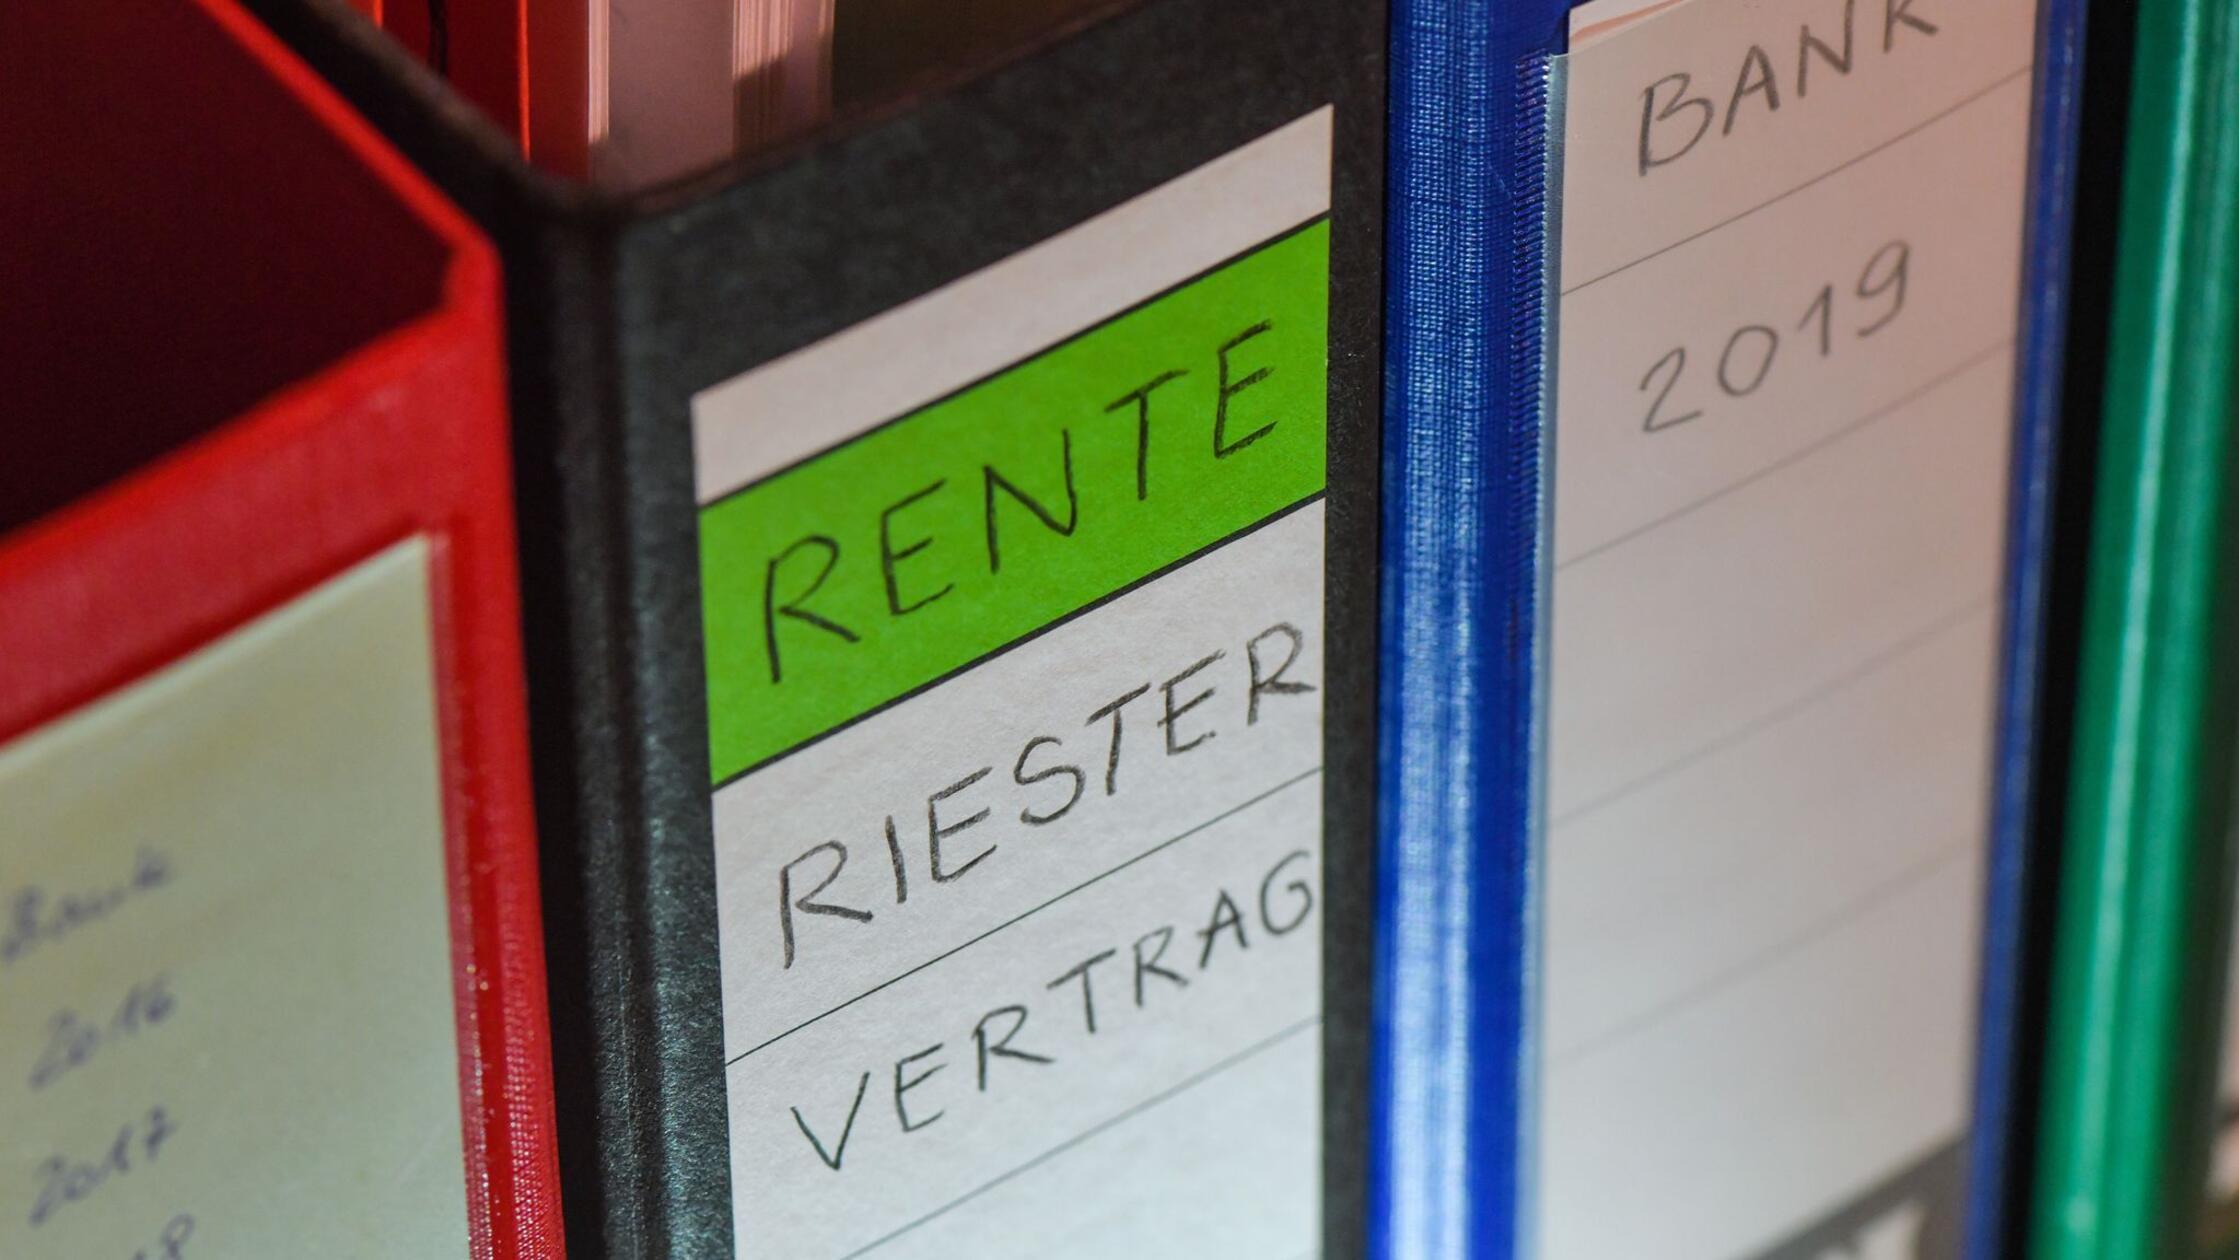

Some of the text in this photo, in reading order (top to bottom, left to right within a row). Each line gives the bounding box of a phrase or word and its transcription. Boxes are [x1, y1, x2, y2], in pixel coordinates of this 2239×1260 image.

[1638, 0, 1939, 177] BANK
[1639, 240, 1910, 433] 2019
[764, 319, 1277, 684] RENTE
[779, 621, 1317, 970] RIESTER
[791, 849, 1313, 1171] VERTRAG
[28, 1106, 178, 1226] 2017
